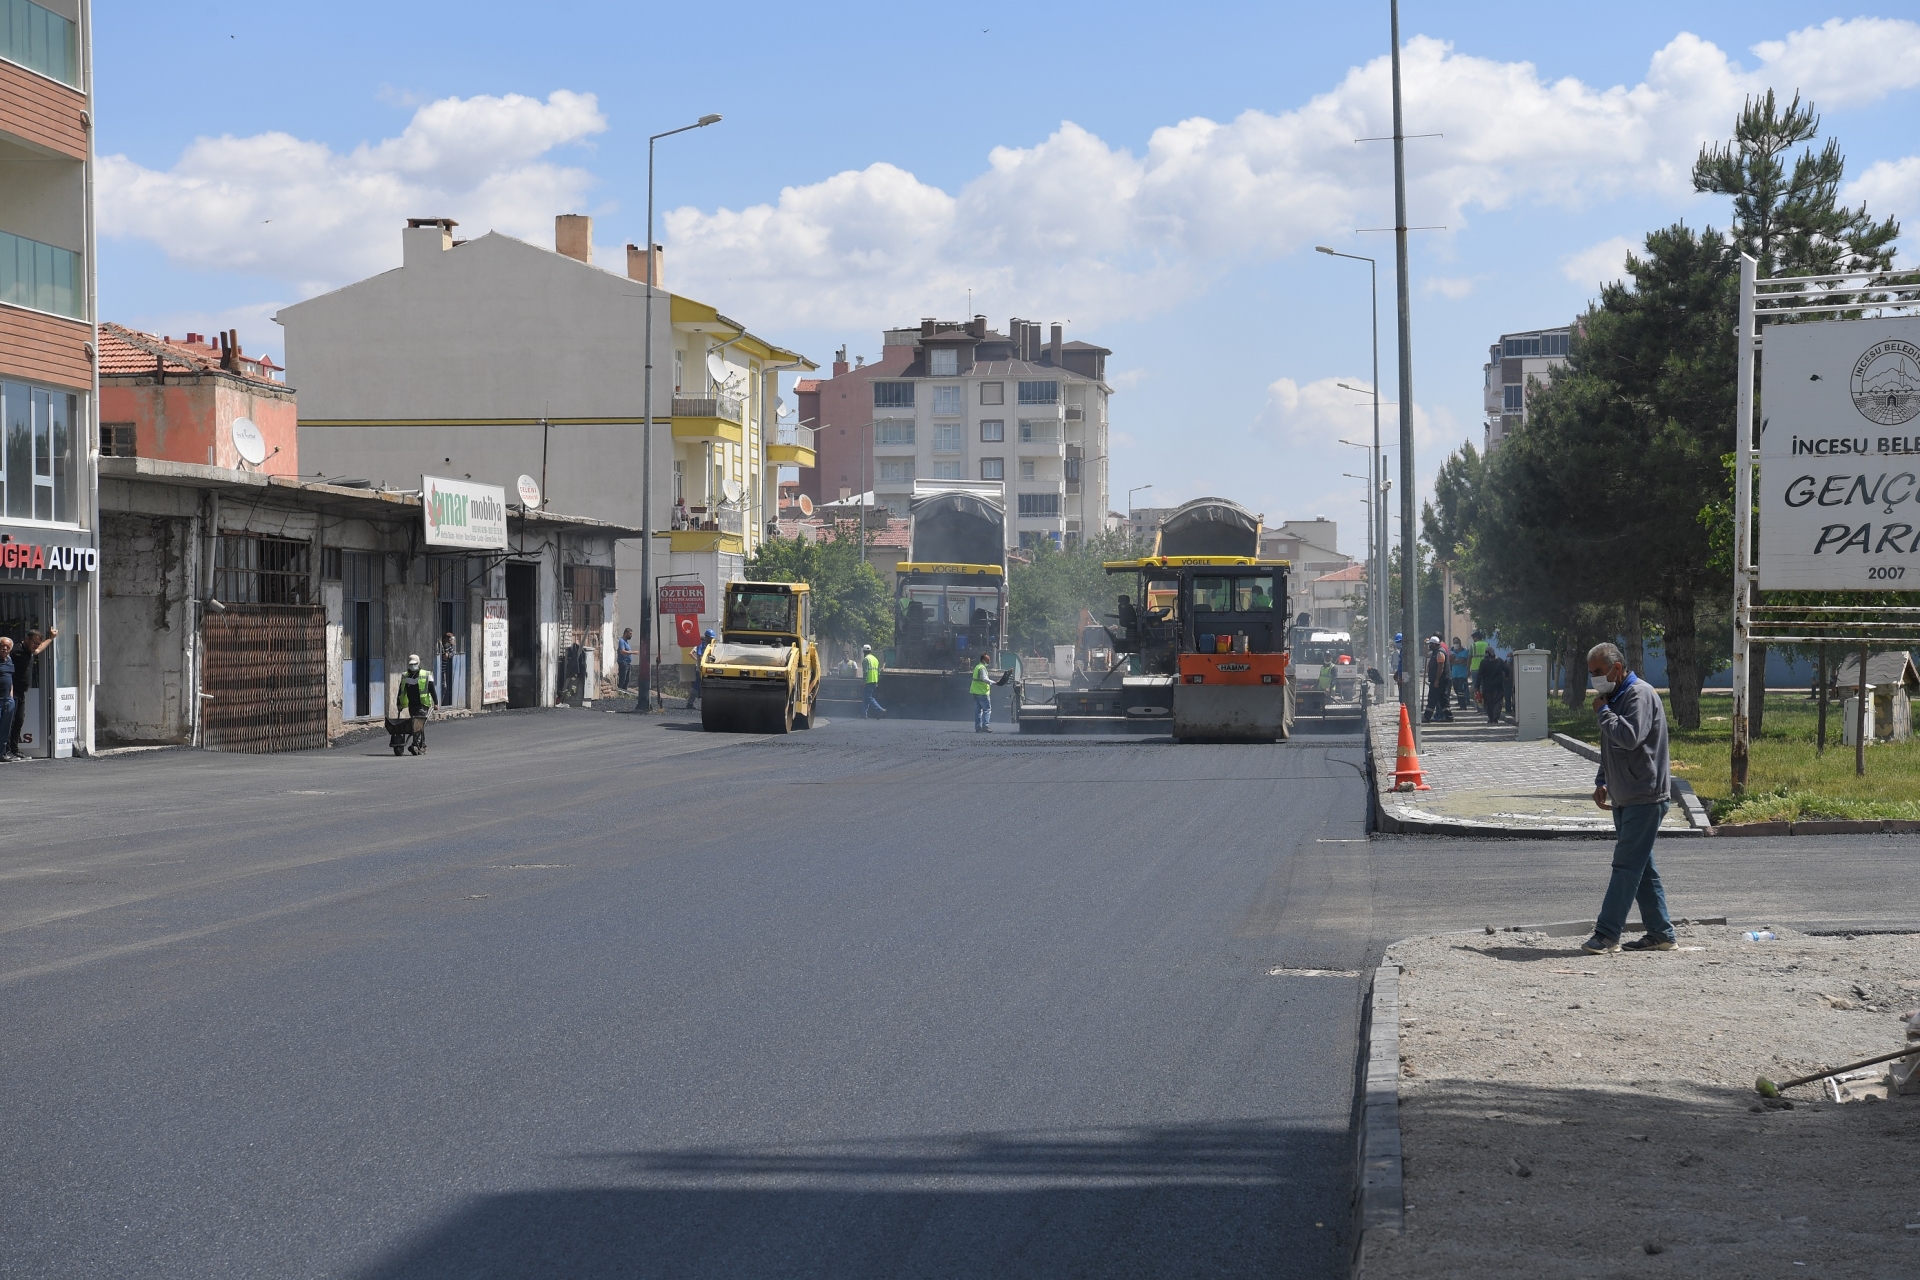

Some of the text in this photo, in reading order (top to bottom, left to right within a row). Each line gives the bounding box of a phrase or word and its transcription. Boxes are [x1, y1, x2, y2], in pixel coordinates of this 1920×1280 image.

[1854, 343, 1920, 377] İNCESU BELEDİY
[1792, 435, 1868, 455] İNCESU
[470, 495, 502, 526] mobilya
[48, 545, 97, 572] AUTO
[1181, 558, 1212, 566] VÖGELE
[1868, 567, 1905, 580] 2007
[660, 587, 704, 598] ÖZTÜRK
